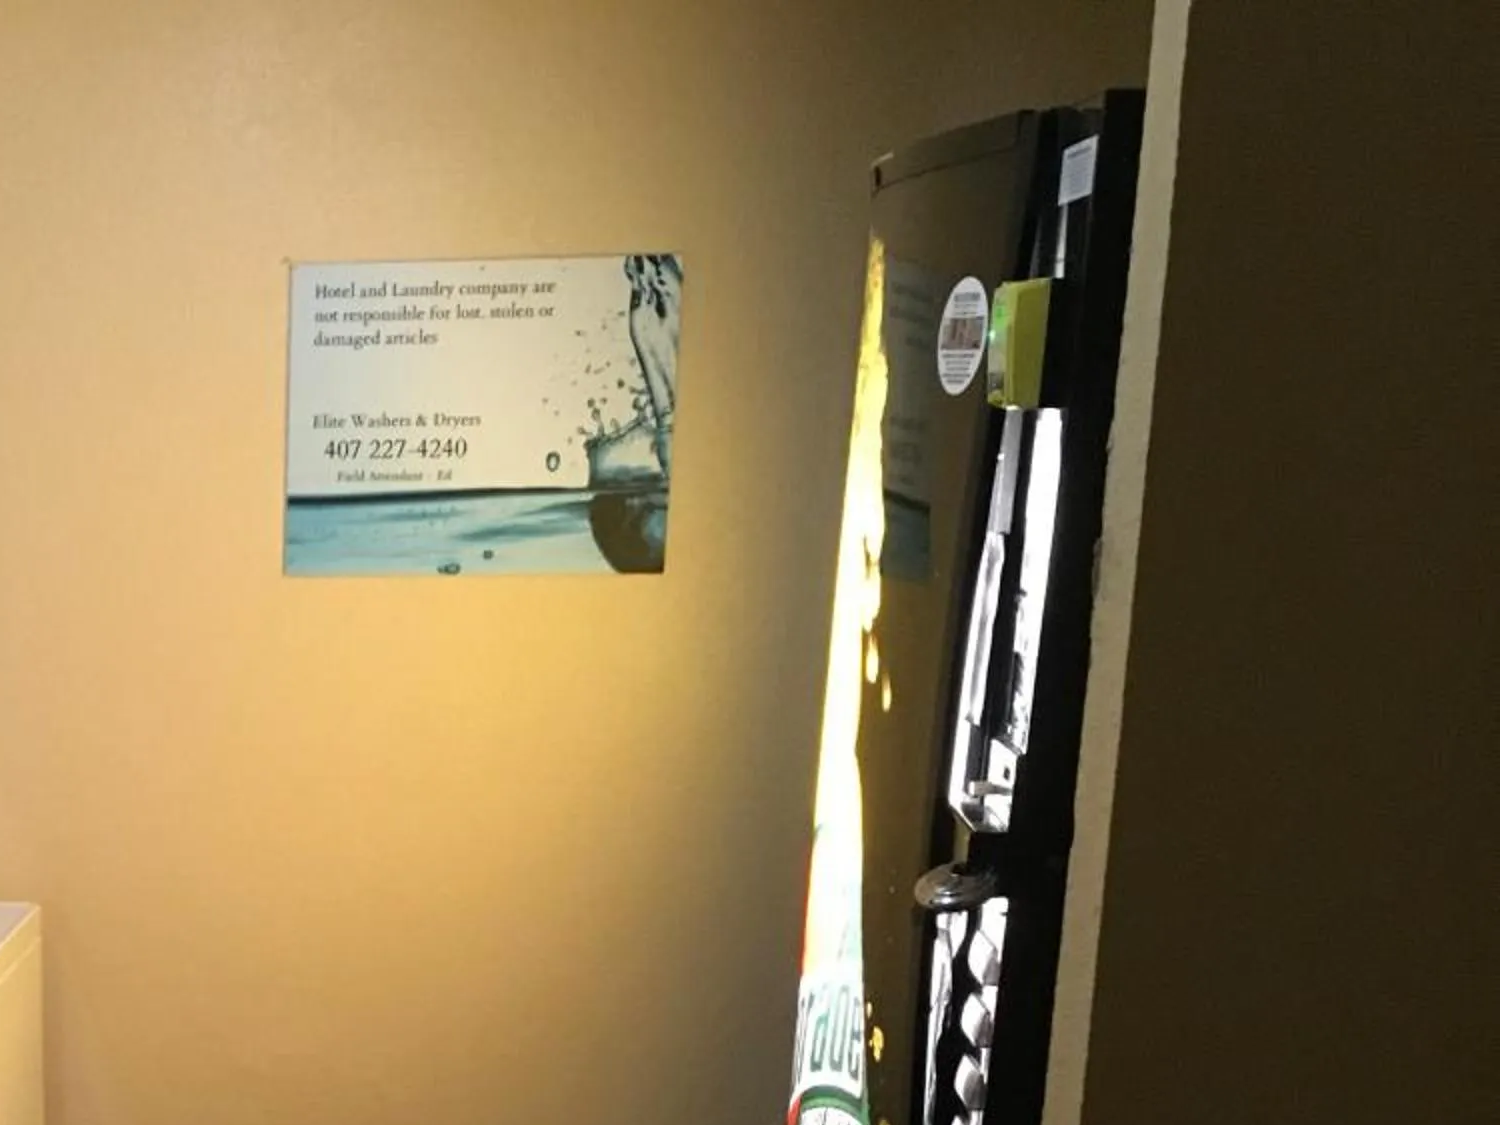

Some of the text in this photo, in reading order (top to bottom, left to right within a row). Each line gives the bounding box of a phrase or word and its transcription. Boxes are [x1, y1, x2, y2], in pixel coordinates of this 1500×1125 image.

[314, 279, 556, 300] Hotel and Laundry company are
[314, 310, 338, 322] not
[342, 304, 426, 327] responsible
[429, 304, 451, 320] for
[489, 302, 535, 319] stolen
[538, 306, 555, 318] or
[313, 327, 439, 350] damaged articles
[312, 411, 482, 430] Elite Washers & Dryers
[323, 437, 469, 461] 407 227-4240
